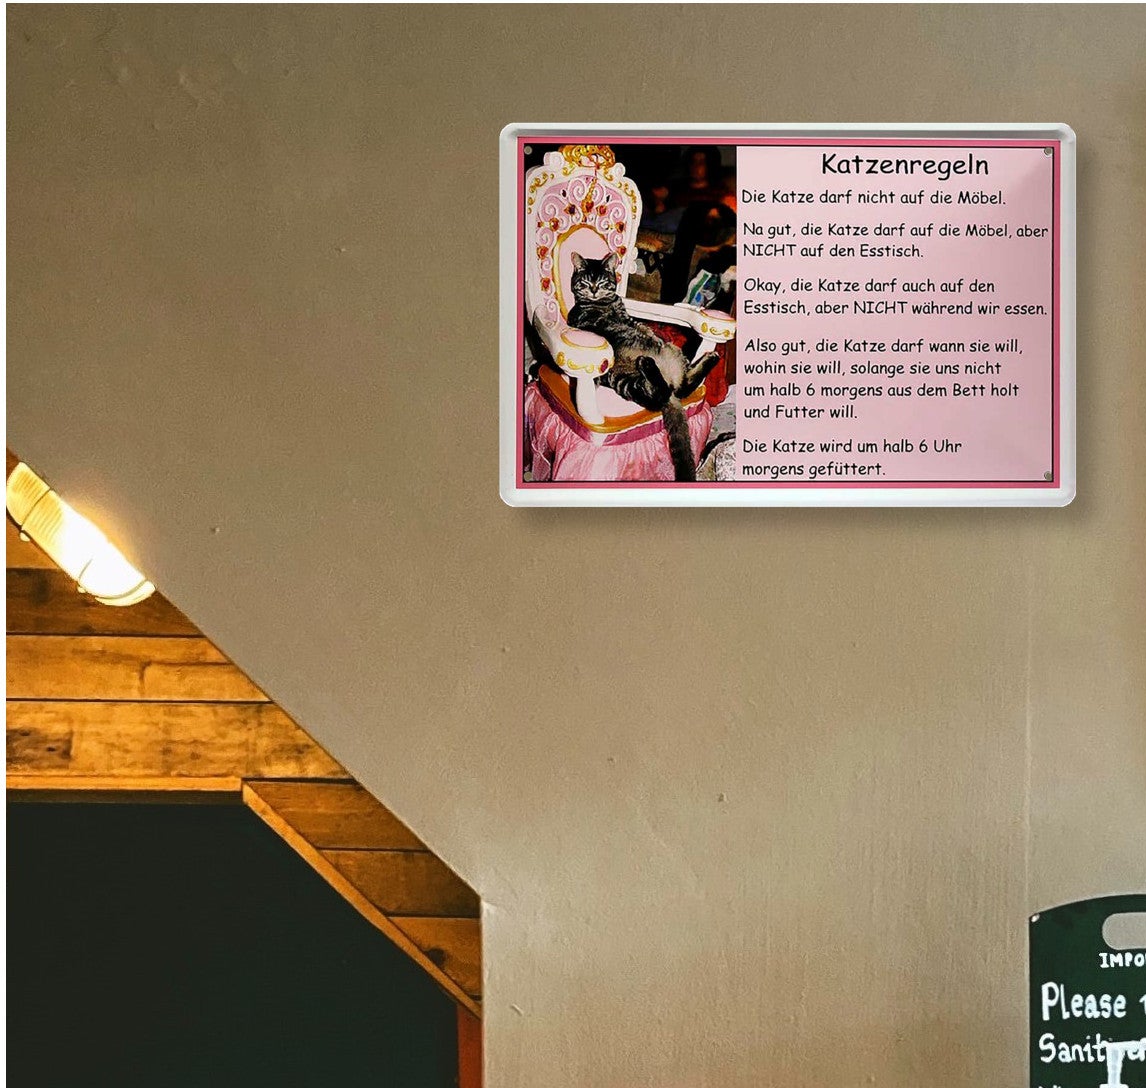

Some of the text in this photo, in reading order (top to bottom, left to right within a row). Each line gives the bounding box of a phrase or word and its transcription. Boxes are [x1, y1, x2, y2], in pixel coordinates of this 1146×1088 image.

[822, 152, 989, 180] Katzenregeln
[741, 189, 1006, 205] Die Katze darf nicht auf die Möbel.
[743, 222, 1049, 240] Na gut, die Katze darf auf die Möbel, aber
[743, 243, 924, 258] NICHT auf den Esstisch.
[743, 277, 995, 296] Okay, die Katze darf auch auf den
[743, 299, 1048, 316] Esstisch, aber NICHT während wir essen.
[744, 337, 1023, 356] Also gut, die Katze darf wann sie will,
[744, 359, 1002, 379] wohin sie will, solange sie uns nicht
[744, 382, 1020, 401] um halb 6 morgens aus dem Bett holt
[744, 404, 858, 419] und Futter will.
[742, 438, 963, 454] Die Katze wird um halb 6 Uhr
[742, 460, 887, 480] morgens gefüttert.
[1041, 981, 1127, 1021] Please
